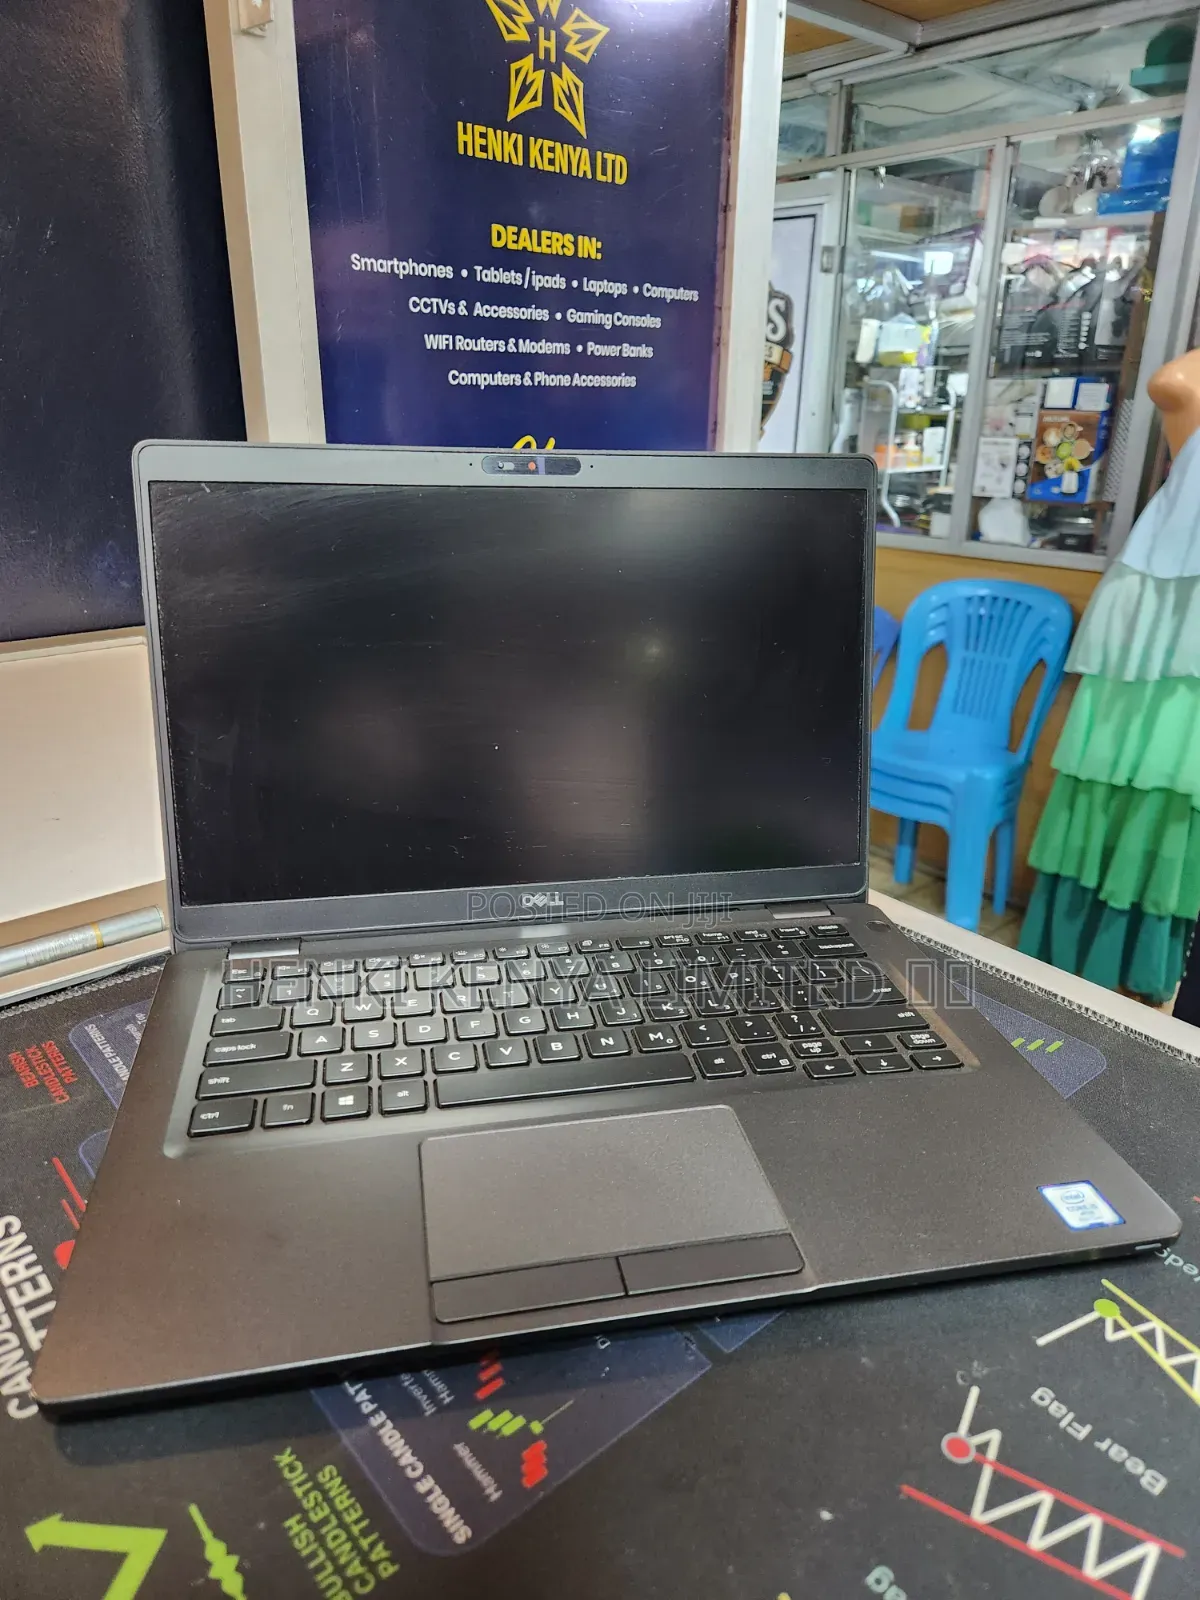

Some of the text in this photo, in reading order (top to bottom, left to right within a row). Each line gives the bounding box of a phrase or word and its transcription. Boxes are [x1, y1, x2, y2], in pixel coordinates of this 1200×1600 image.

[538, 26, 557, 63] H
[457, 121, 628, 185] HENKI KENYA LTD
[491, 223, 602, 260] DEALERS IN:
[350, 253, 453, 279] Smartphones
[583, 277, 628, 298] Laptops
[642, 283, 699, 303] Computers
[409, 296, 661, 329] CCTVs & Accessories Gaming Consoles
[424, 334, 654, 358] WIFI Routers & Modems Power Banks
[448, 370, 637, 390] Computers & Phone Accessories
[522, 892, 564, 907] DELL
[550, 987, 561, 995] Y
[355, 1003, 372, 1011] W
[407, 999, 418, 1007] E
[661, 1003, 674, 1011] K
[306, 1008, 319, 1016] Q
[566, 1012, 580, 1020] H
[616, 1007, 626, 1016] J
[470, 1020, 481, 1028] F
[518, 1016, 531, 1024] G
[418, 1025, 431, 1033] D
[368, 1030, 380, 1038] S
[649, 1032, 664, 1041] M
[910, 1033, 930, 1041] page
[84, 1024, 117, 1059] PATTERNS
[315, 1035, 328, 1044] A
[600, 1037, 614, 1046] N
[214, 1043, 257, 1053] caps lock
[551, 1042, 563, 1051] B
[802, 1041, 822, 1049] page
[500, 1047, 513, 1056] V
[448, 1052, 461, 1061] C
[713, 1057, 725, 1065] alt
[41, 1041, 78, 1084] PATTERNS
[394, 1057, 408, 1066] X
[8, 1051, 39, 1088] BEARISH
[340, 1062, 354, 1072] Z
[25, 1044, 70, 1104] CANDLESTICK
[207, 1077, 230, 1085] shift
[397, 1090, 409, 1098] alt
[200, 1111, 219, 1120] ctrl
[1030, 1386, 1168, 1496] Bear Flag
[344, 1381, 472, 1544] SINGLE CANDLE PAT
[453, 1442, 503, 1502] Hammer
[273, 1446, 376, 1594] CANDLESTICK
[317, 1464, 400, 1579] PATTERNS
